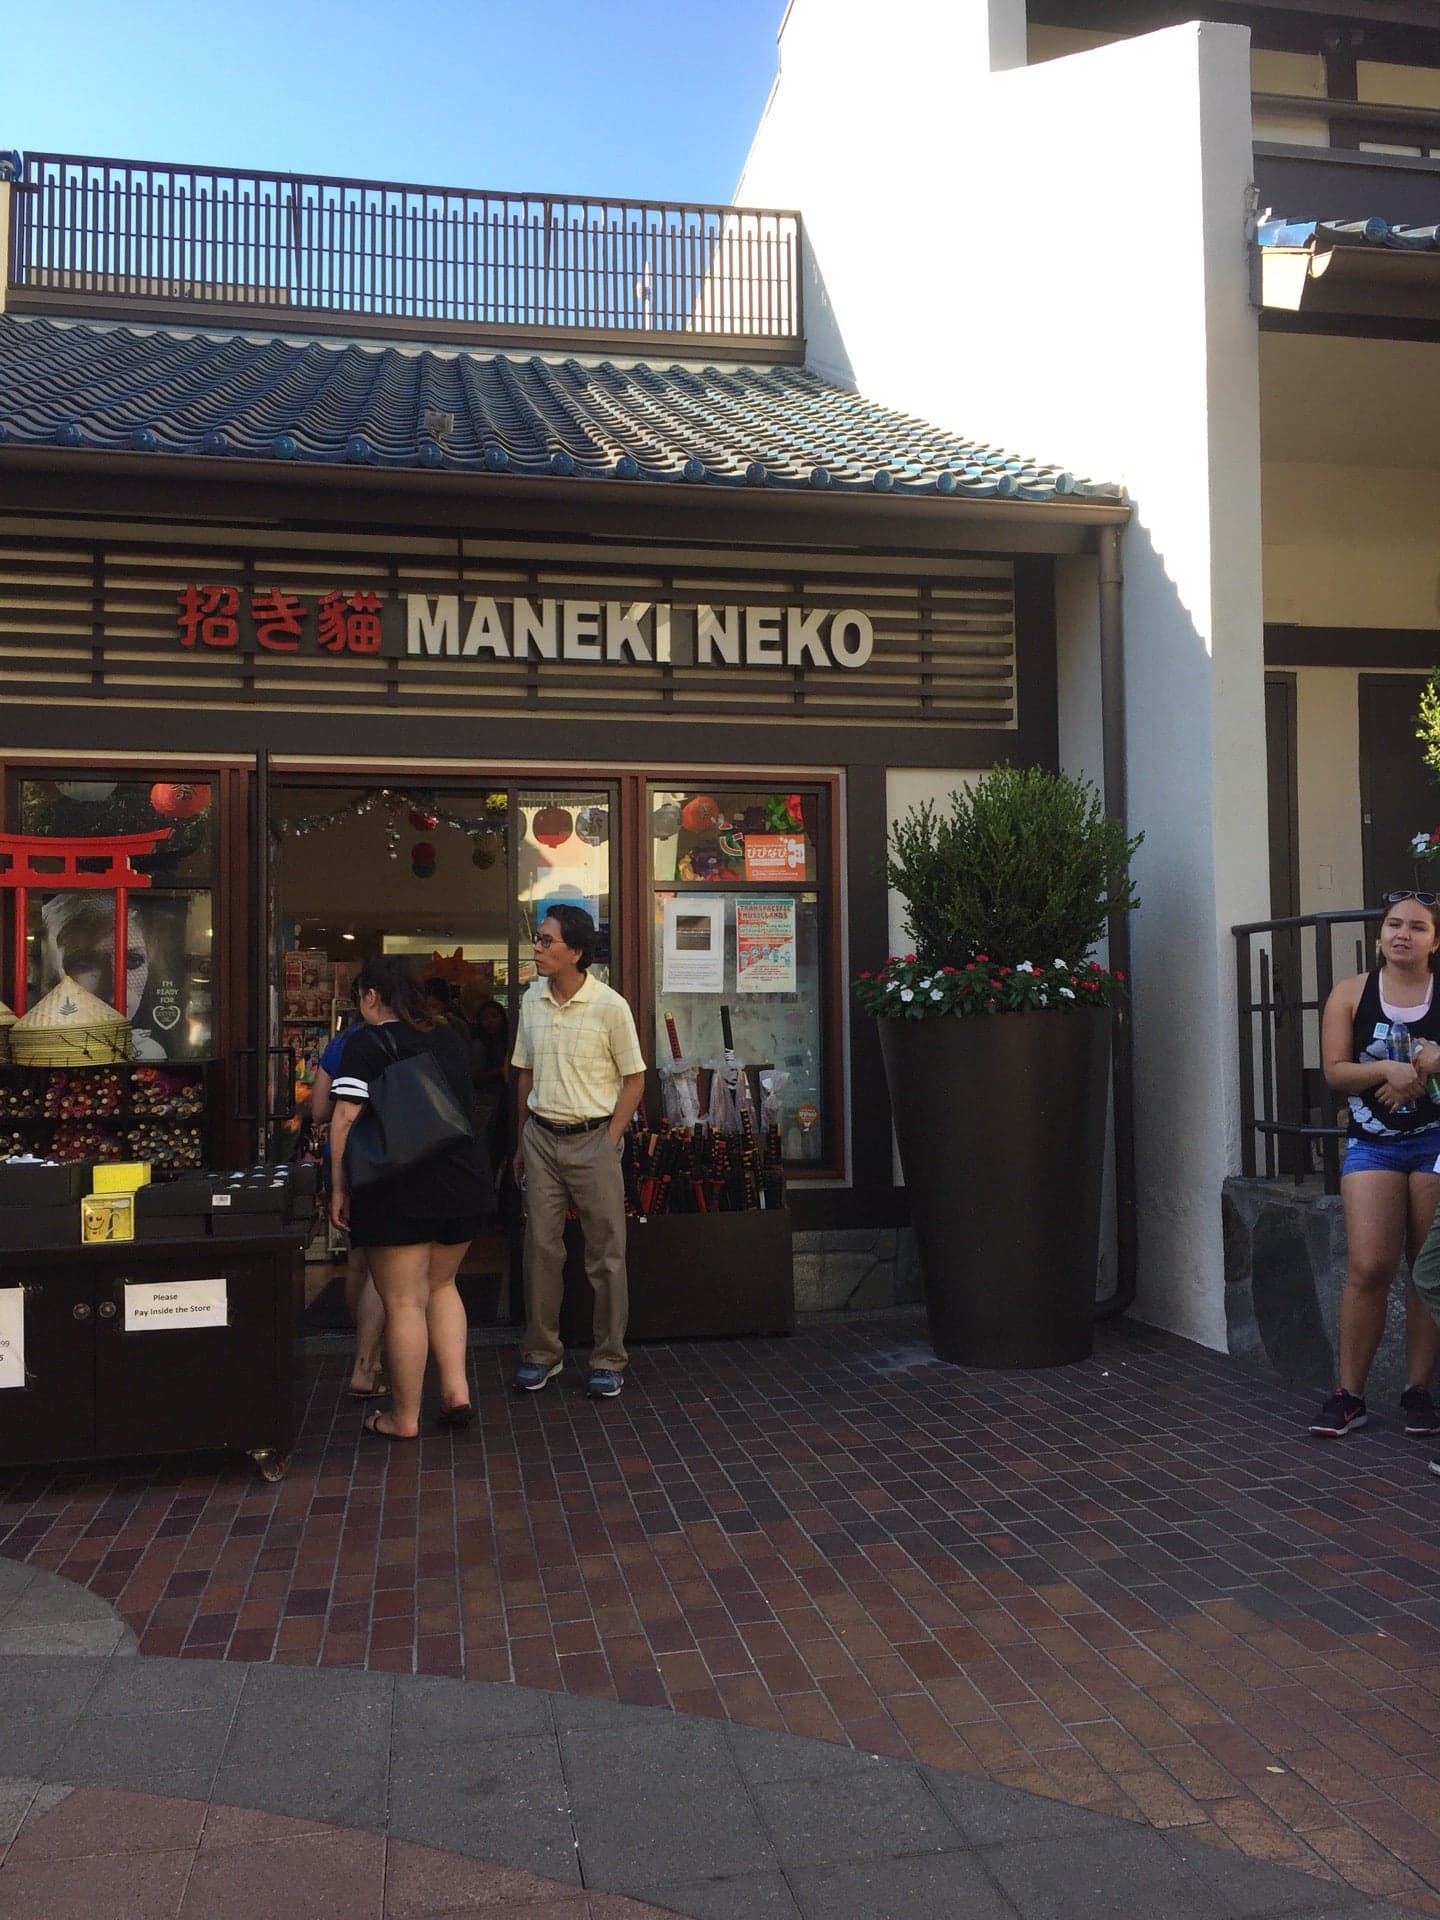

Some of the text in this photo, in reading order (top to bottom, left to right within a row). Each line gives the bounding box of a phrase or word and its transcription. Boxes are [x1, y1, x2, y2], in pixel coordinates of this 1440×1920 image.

[406, 593, 875, 668] MANEKI NEKO
[134, 1304, 211, 1317] Pay Inside the Store
